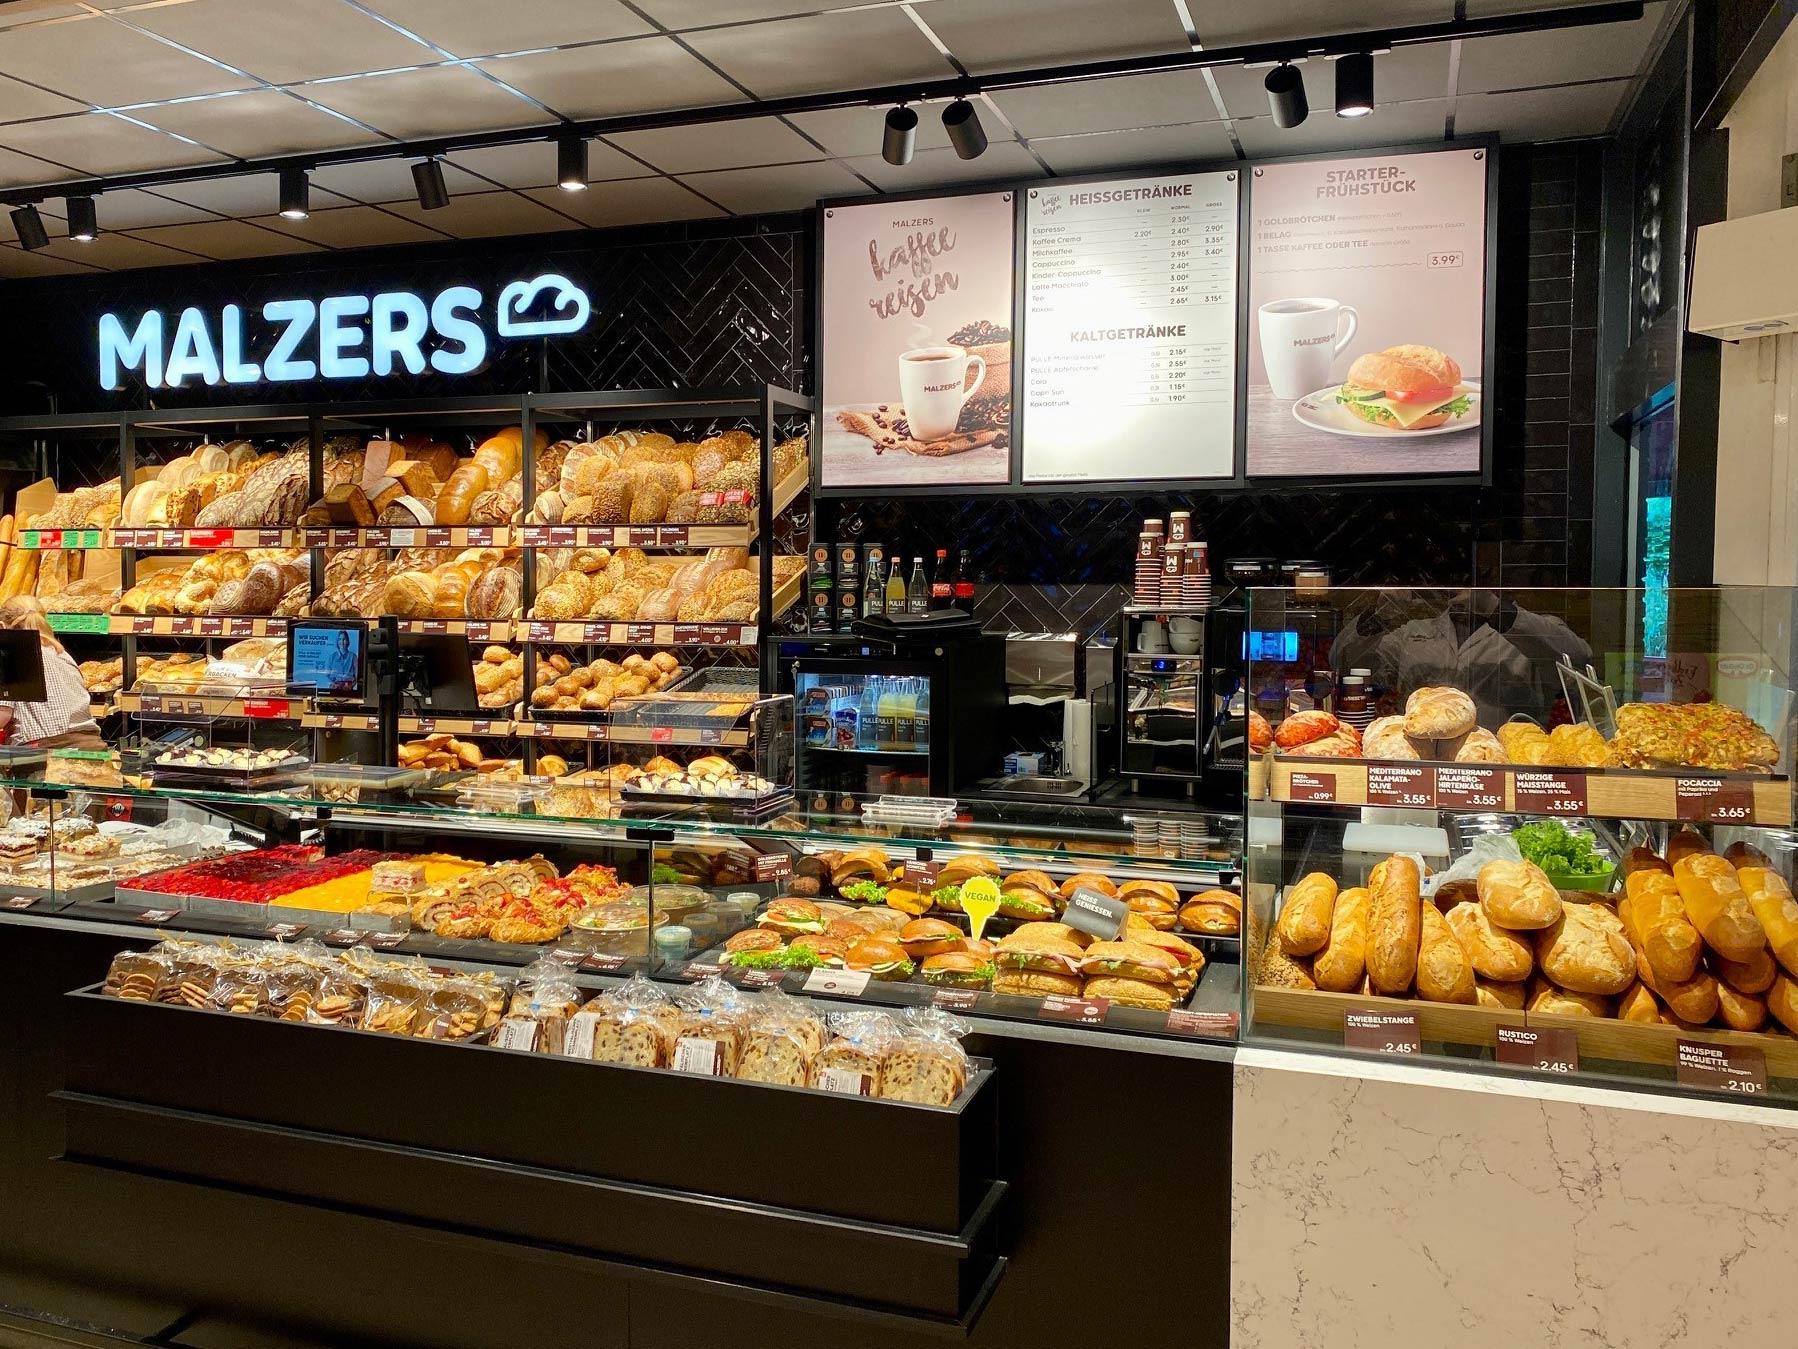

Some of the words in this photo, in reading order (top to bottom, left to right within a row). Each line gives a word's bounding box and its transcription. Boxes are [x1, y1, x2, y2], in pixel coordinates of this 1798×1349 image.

[1326, 166, 1406, 183] STARTER-
[1316, 178, 1416, 199] FRÜHSTÜCK
[1069, 184, 1193, 206] HEISSGETRÄNKE
[892, 217, 934, 229] MALZERS
[1032, 226, 1066, 236] Espresso
[1032, 238, 1056, 246] Kaffee
[1056, 236, 1082, 244] Crema
[1205, 224, 1224, 233] 2.90€
[1264, 230, 1291, 240] BELAG
[1264, 244, 1290, 253] TASSE
[1291, 242, 1323, 252] KAFFEE
[1325, 240, 1350, 249] ODER
[1351, 239, 1368, 248] TEE
[868, 225, 957, 281] kaffee
[1032, 248, 1073, 257] Milchkaffee
[1032, 259, 1076, 269] Cappuccino
[1170, 250, 1189, 258] 2.95€
[1431, 254, 1461, 266] 3.99€
[869, 270, 959, 320] reisen
[1170, 297, 1189, 305] 2.65€
[1204, 295, 1222, 303] 3.15€
[98, 286, 487, 391] MALZERS
[1070, 324, 1187, 342] KALTGETRÄNKE
[1293, 335, 1331, 347] MALZERS
[1169, 348, 1186, 356] 2.15€
[923, 382, 957, 393] MALZERS
[1369, 767, 1423, 777] MEDITERRANO
[1438, 767, 1493, 777] MEDITERRANO
[1516, 772, 1553, 781] WÜRZIGE
[1369, 774, 1411, 783] KALAMATA-
[1438, 774, 1480, 783] JALAPEÑO-
[1677, 779, 1722, 787] FOCACCIA
[1369, 782, 1392, 790] OLIVE
[1438, 780, 1484, 790] HIRTENKÄSE
[1516, 780, 1567, 789] MAISSTANGE
[1403, 794, 1431, 804] 3.55€
[1473, 795, 1502, 805] 3.55€
[1553, 800, 1584, 811] 3.55€
[1718, 807, 1751, 818] 3.65€
[964, 891, 996, 903] VEGAN
[1078, 892, 1098, 905] HEISS
[1347, 1015, 1414, 1024] ZWIEBELSTANGE
[1498, 1029, 1538, 1040] RUSTICO
[1386, 1043, 1417, 1053] 2.45€
[1679, 1044, 1723, 1058] KNUSPER
[1679, 1053, 1729, 1067] BAGUETTE
[1540, 1060, 1574, 1073] 2.45€
[1728, 1080, 1763, 1092] 2.10€
